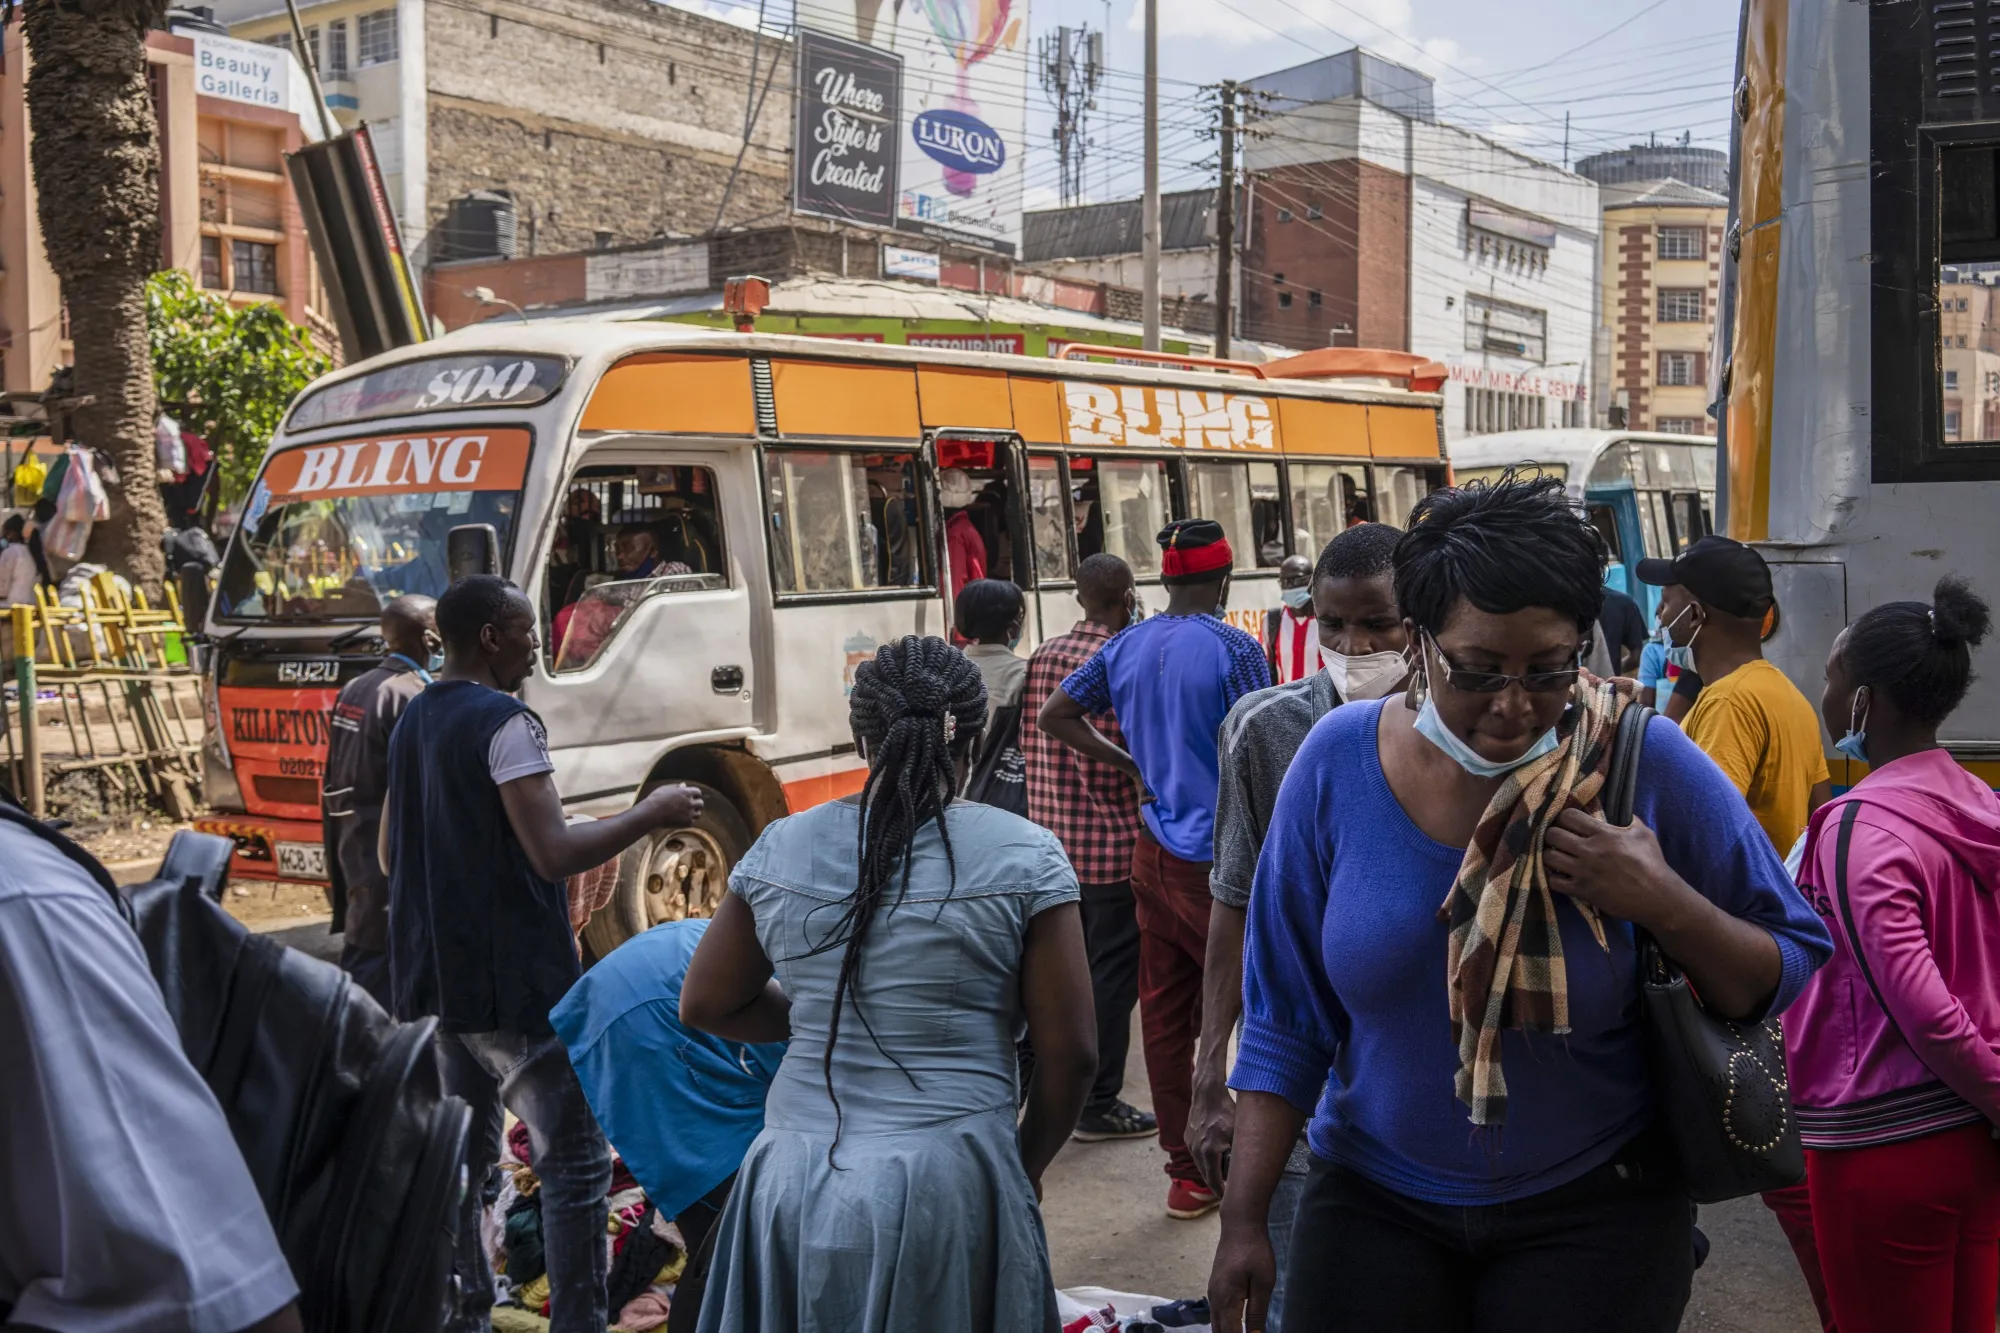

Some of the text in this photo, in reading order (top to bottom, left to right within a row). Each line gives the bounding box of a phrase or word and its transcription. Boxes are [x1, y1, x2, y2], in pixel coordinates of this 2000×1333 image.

[201, 50, 271, 82] Beauty
[201, 74, 279, 104] Galleria
[815, 66, 884, 113] Where
[814, 107, 882, 156] Style is
[918, 118, 1000, 162] LURON
[811, 148, 885, 194] Created
[1489, 370, 1541, 395] MIRACLE
[1547, 381, 1588, 401] CENTRE
[1063, 381, 1274, 450] BLING
[288, 436, 489, 493] BLING
[278, 661, 340, 682] ISUZU
[232, 708, 331, 746] KILLETON
